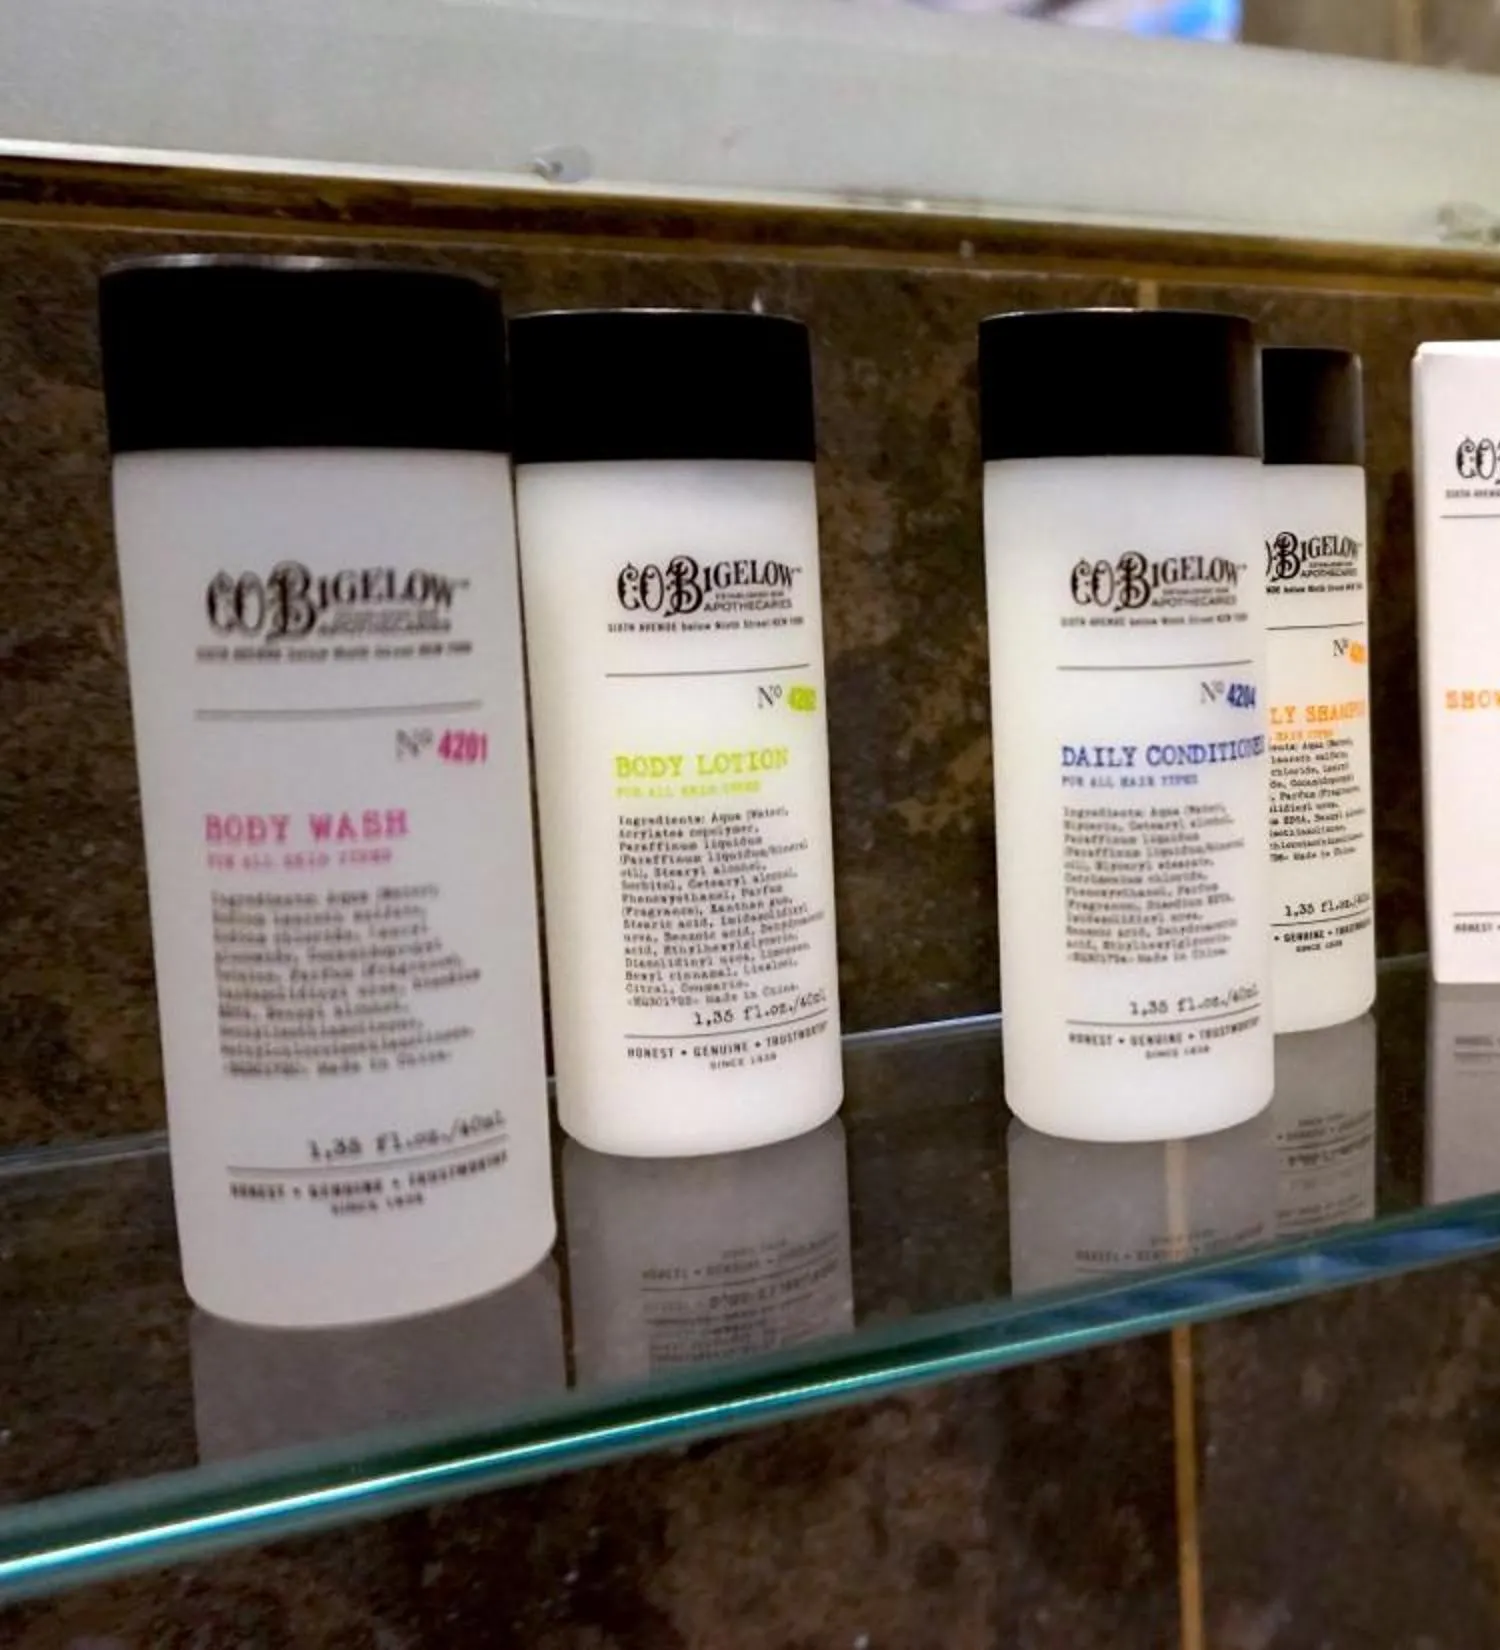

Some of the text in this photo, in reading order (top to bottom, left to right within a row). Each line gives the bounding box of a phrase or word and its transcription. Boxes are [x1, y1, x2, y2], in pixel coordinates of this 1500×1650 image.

[703, 599, 793, 612] APOTHECARIES
[1226, 682, 1256, 709] 4204
[437, 729, 488, 765] 4201
[615, 747, 790, 778] BODY LOTION
[1061, 745, 1137, 768] DAILY
[1061, 773, 1198, 788] FOR ALL HAIR TYPES
[204, 808, 411, 844] BODY WASH
[619, 814, 706, 826] Ingredients:
[711, 811, 741, 824] Aqua
[619, 836, 763, 852] Paraffinum liquidum
[654, 867, 706, 880] Stearyl
[688, 875, 746, 889] Cetearyl
[741, 885, 783, 897] Parfum
[1129, 1000, 1169, 1017] 1,35
[695, 1010, 736, 1026] 1,35
[627, 1047, 673, 1059] HONEST
[693, 1042, 748, 1057] GENUINE
[709, 1058, 744, 1069] SINCE
[309, 1136, 362, 1161] 1,35
